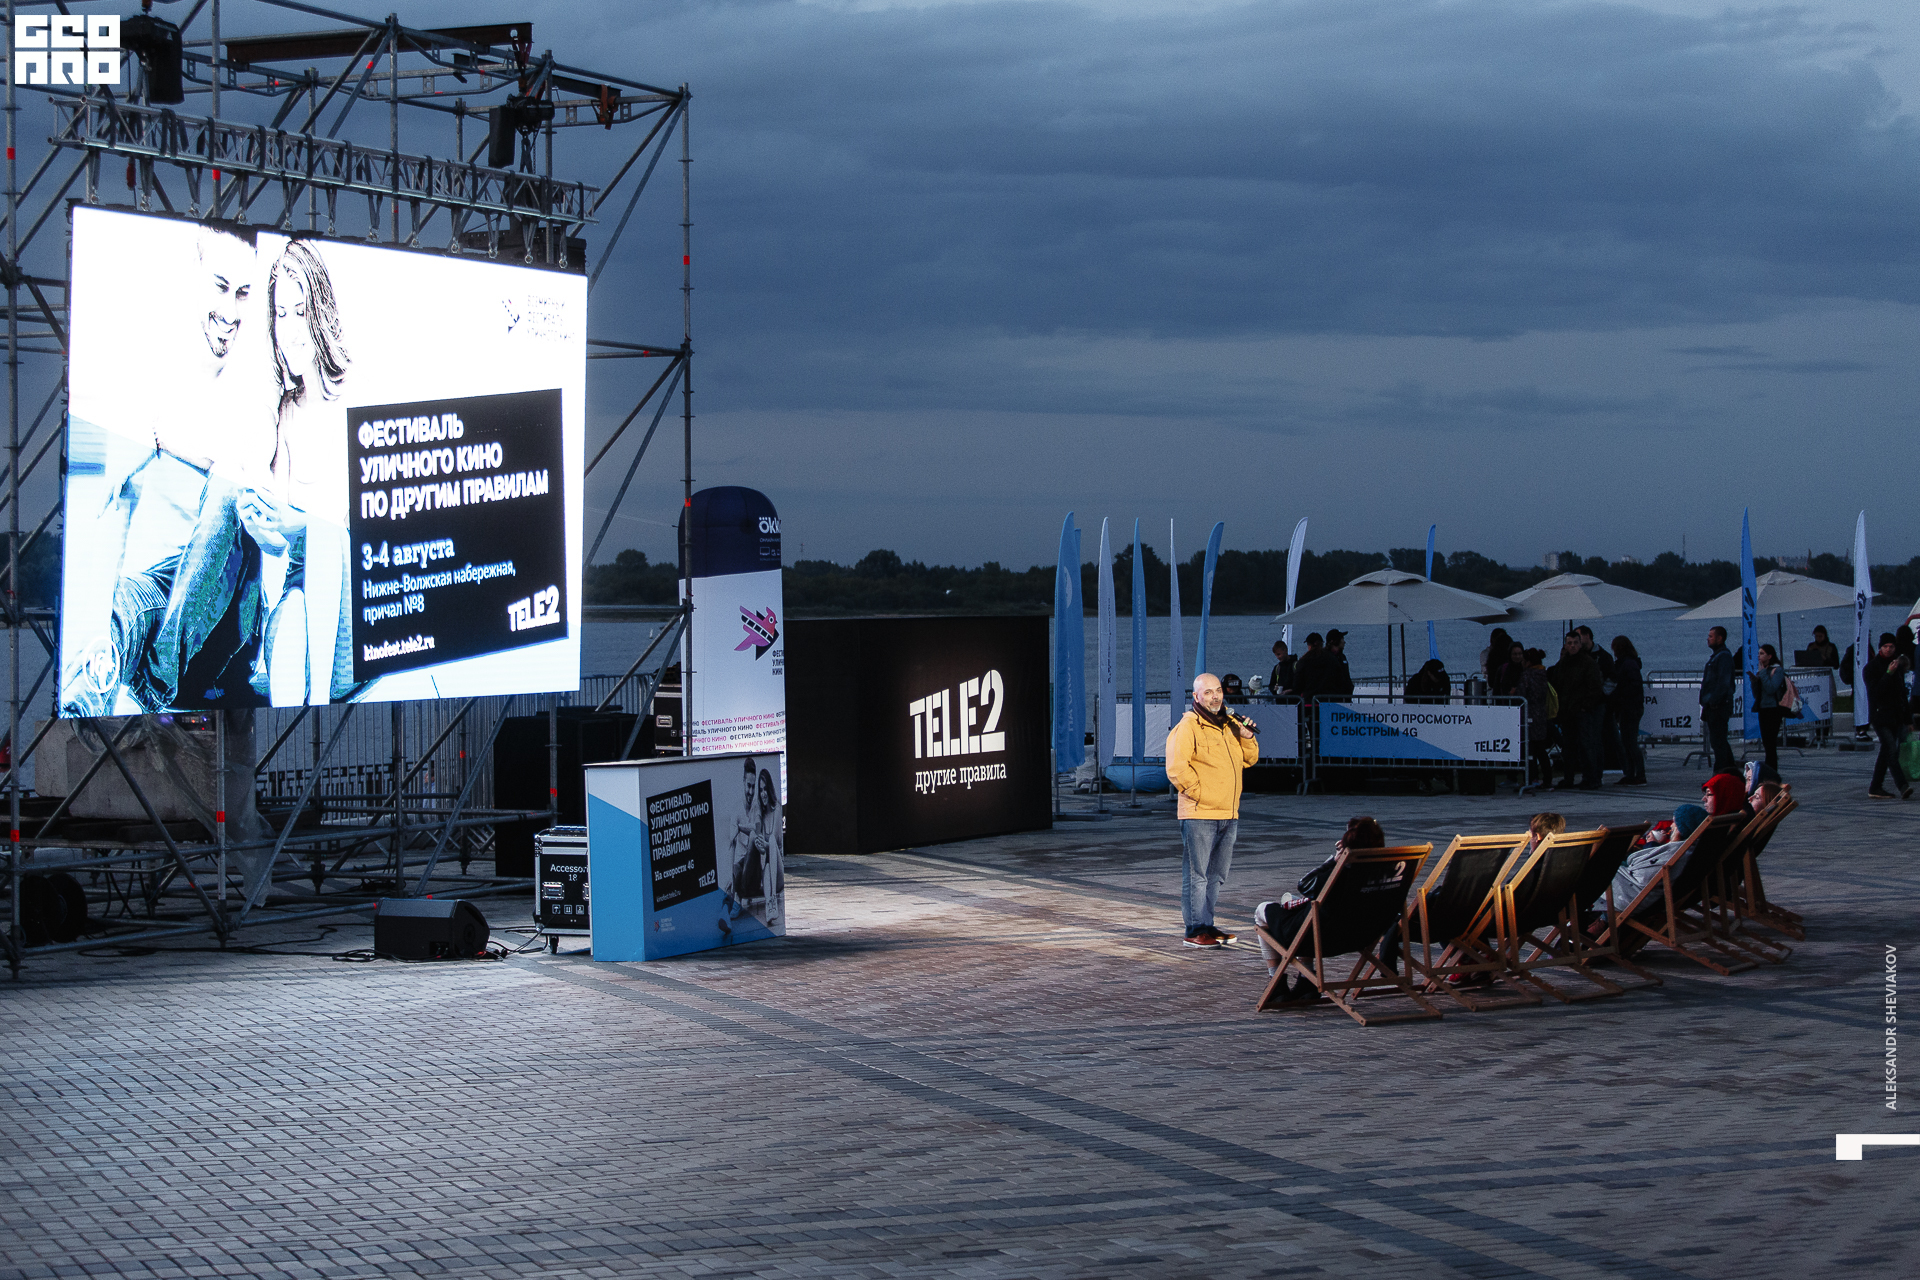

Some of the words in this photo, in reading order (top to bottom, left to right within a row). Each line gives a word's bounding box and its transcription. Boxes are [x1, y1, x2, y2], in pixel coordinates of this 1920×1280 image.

[358, 413, 464, 448] ФЕСТИВАЛЬ
[360, 448, 454, 484] УЛИЧНОГО
[457, 442, 503, 472] КИНО
[361, 490, 388, 519] ПО
[391, 481, 460, 520] ДРУГИМ
[463, 469, 549, 504] ПРАВИЛАМ
[362, 541, 389, 570] 3-4
[393, 538, 455, 568] августа
[363, 572, 452, 599] Нижне-Волжская
[454, 560, 516, 584] набережная,
[363, 603, 402, 626] причал
[404, 594, 425, 615] №8
[508, 585, 560, 632] TELE2
[364, 634, 435, 661] kinofest.tele2.ru
[702, 718, 732, 726] ФЕСТИВАЛЬ
[734, 714, 762, 723] УЛИЧНОГО
[910, 669, 1005, 758] TELE2
[1331, 712, 1399, 724] ПРИЯТНОГО
[1402, 714, 1472, 725] ПРОСМОТРА
[1660, 715, 1691, 728] TELE2
[1331, 726, 1338, 736] С
[1341, 726, 1399, 737] БЫСТРЫМ
[1402, 728, 1418, 737] 4G
[702, 743, 733, 752] ФЕСТИВАЛЬ
[1475, 738, 1510, 753] TELE2
[915, 768, 956, 794] другие
[960, 763, 1007, 789] правила
[650, 792, 692, 814] ФЕСТИВАЛЬ
[651, 808, 689, 830] УЛИЧНОГО
[690, 802, 709, 818] КИНО
[652, 831, 662, 845] ПО
[664, 822, 692, 844] ДРУГИМ
[653, 838, 691, 861] ПРАВИЛАМ
[550, 864, 589, 873] Accessori
[655, 870, 662, 881] На
[663, 864, 687, 878] скорости
[699, 869, 716, 888] TELE2
